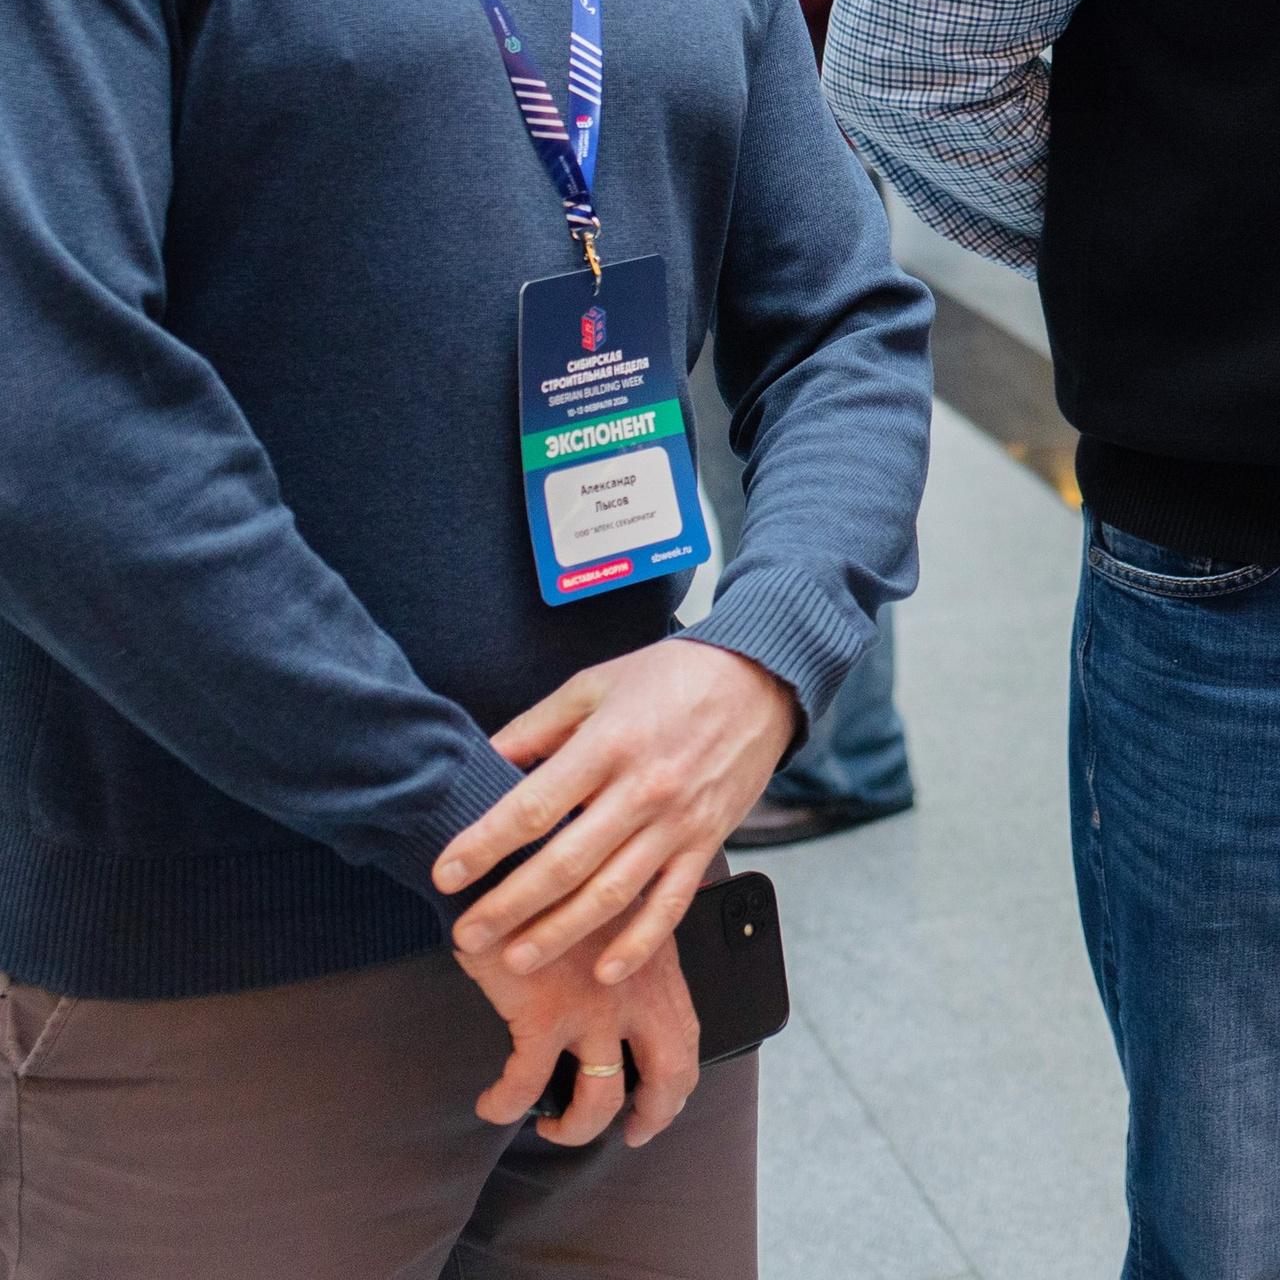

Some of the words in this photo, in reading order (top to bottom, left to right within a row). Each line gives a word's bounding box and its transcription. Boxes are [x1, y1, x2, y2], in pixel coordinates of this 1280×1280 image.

[567, 350, 623, 373] СИБИРСКАЯ
[541, 365, 614, 393] СТРОИТЕЛЬНАЯ
[613, 357, 650, 377] НЕДЕЛЯ
[548, 388, 584, 407] SIBERIAN
[583, 381, 621, 399] BUILDING
[621, 375, 645, 389] WEEK
[545, 411, 656, 458] ЭКСПОНЕНТ
[580, 474, 637, 496] Александр
[595, 496, 630, 513] Лысов
[651, 545, 693, 563] sbweek.ru
